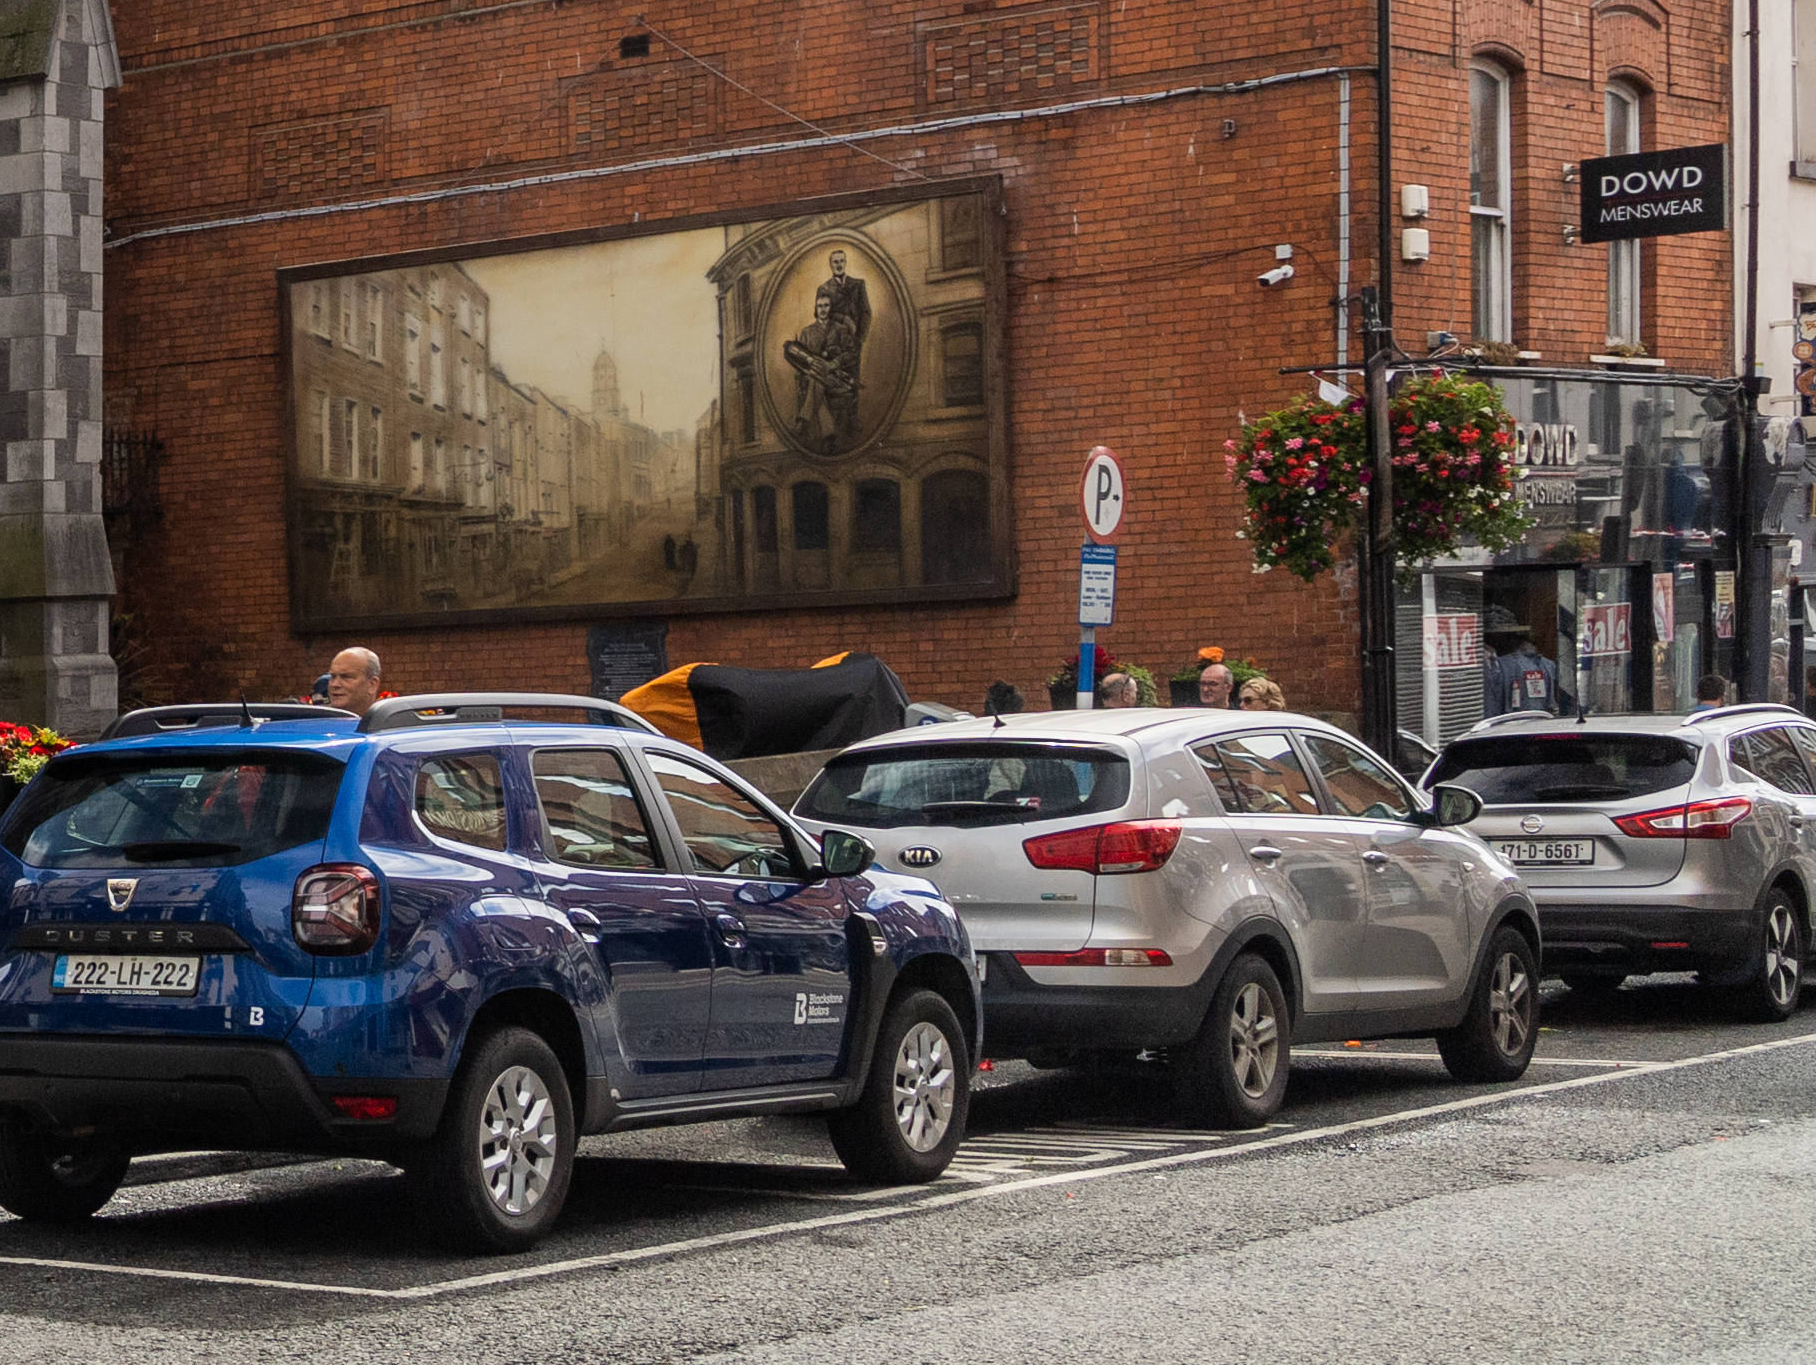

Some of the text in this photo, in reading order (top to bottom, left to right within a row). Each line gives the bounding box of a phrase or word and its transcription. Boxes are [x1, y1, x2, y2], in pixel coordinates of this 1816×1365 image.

[1600, 166, 1704, 198] DOWD
[1599, 197, 1704, 223] MENSWEAR
[1514, 422, 1578, 466] DOWD
[1094, 463, 1113, 525] P
[1514, 478, 1577, 505] MENSWEAR
[1423, 617, 1476, 666] sale
[1581, 608, 1626, 653] sale
[904, 849, 934, 863] KIA
[46, 930, 194, 943] DUSTER
[72, 961, 191, 988] 222-LH-222
[807, 1005, 830, 1016] Motors
[808, 993, 844, 1005] Blackstone
